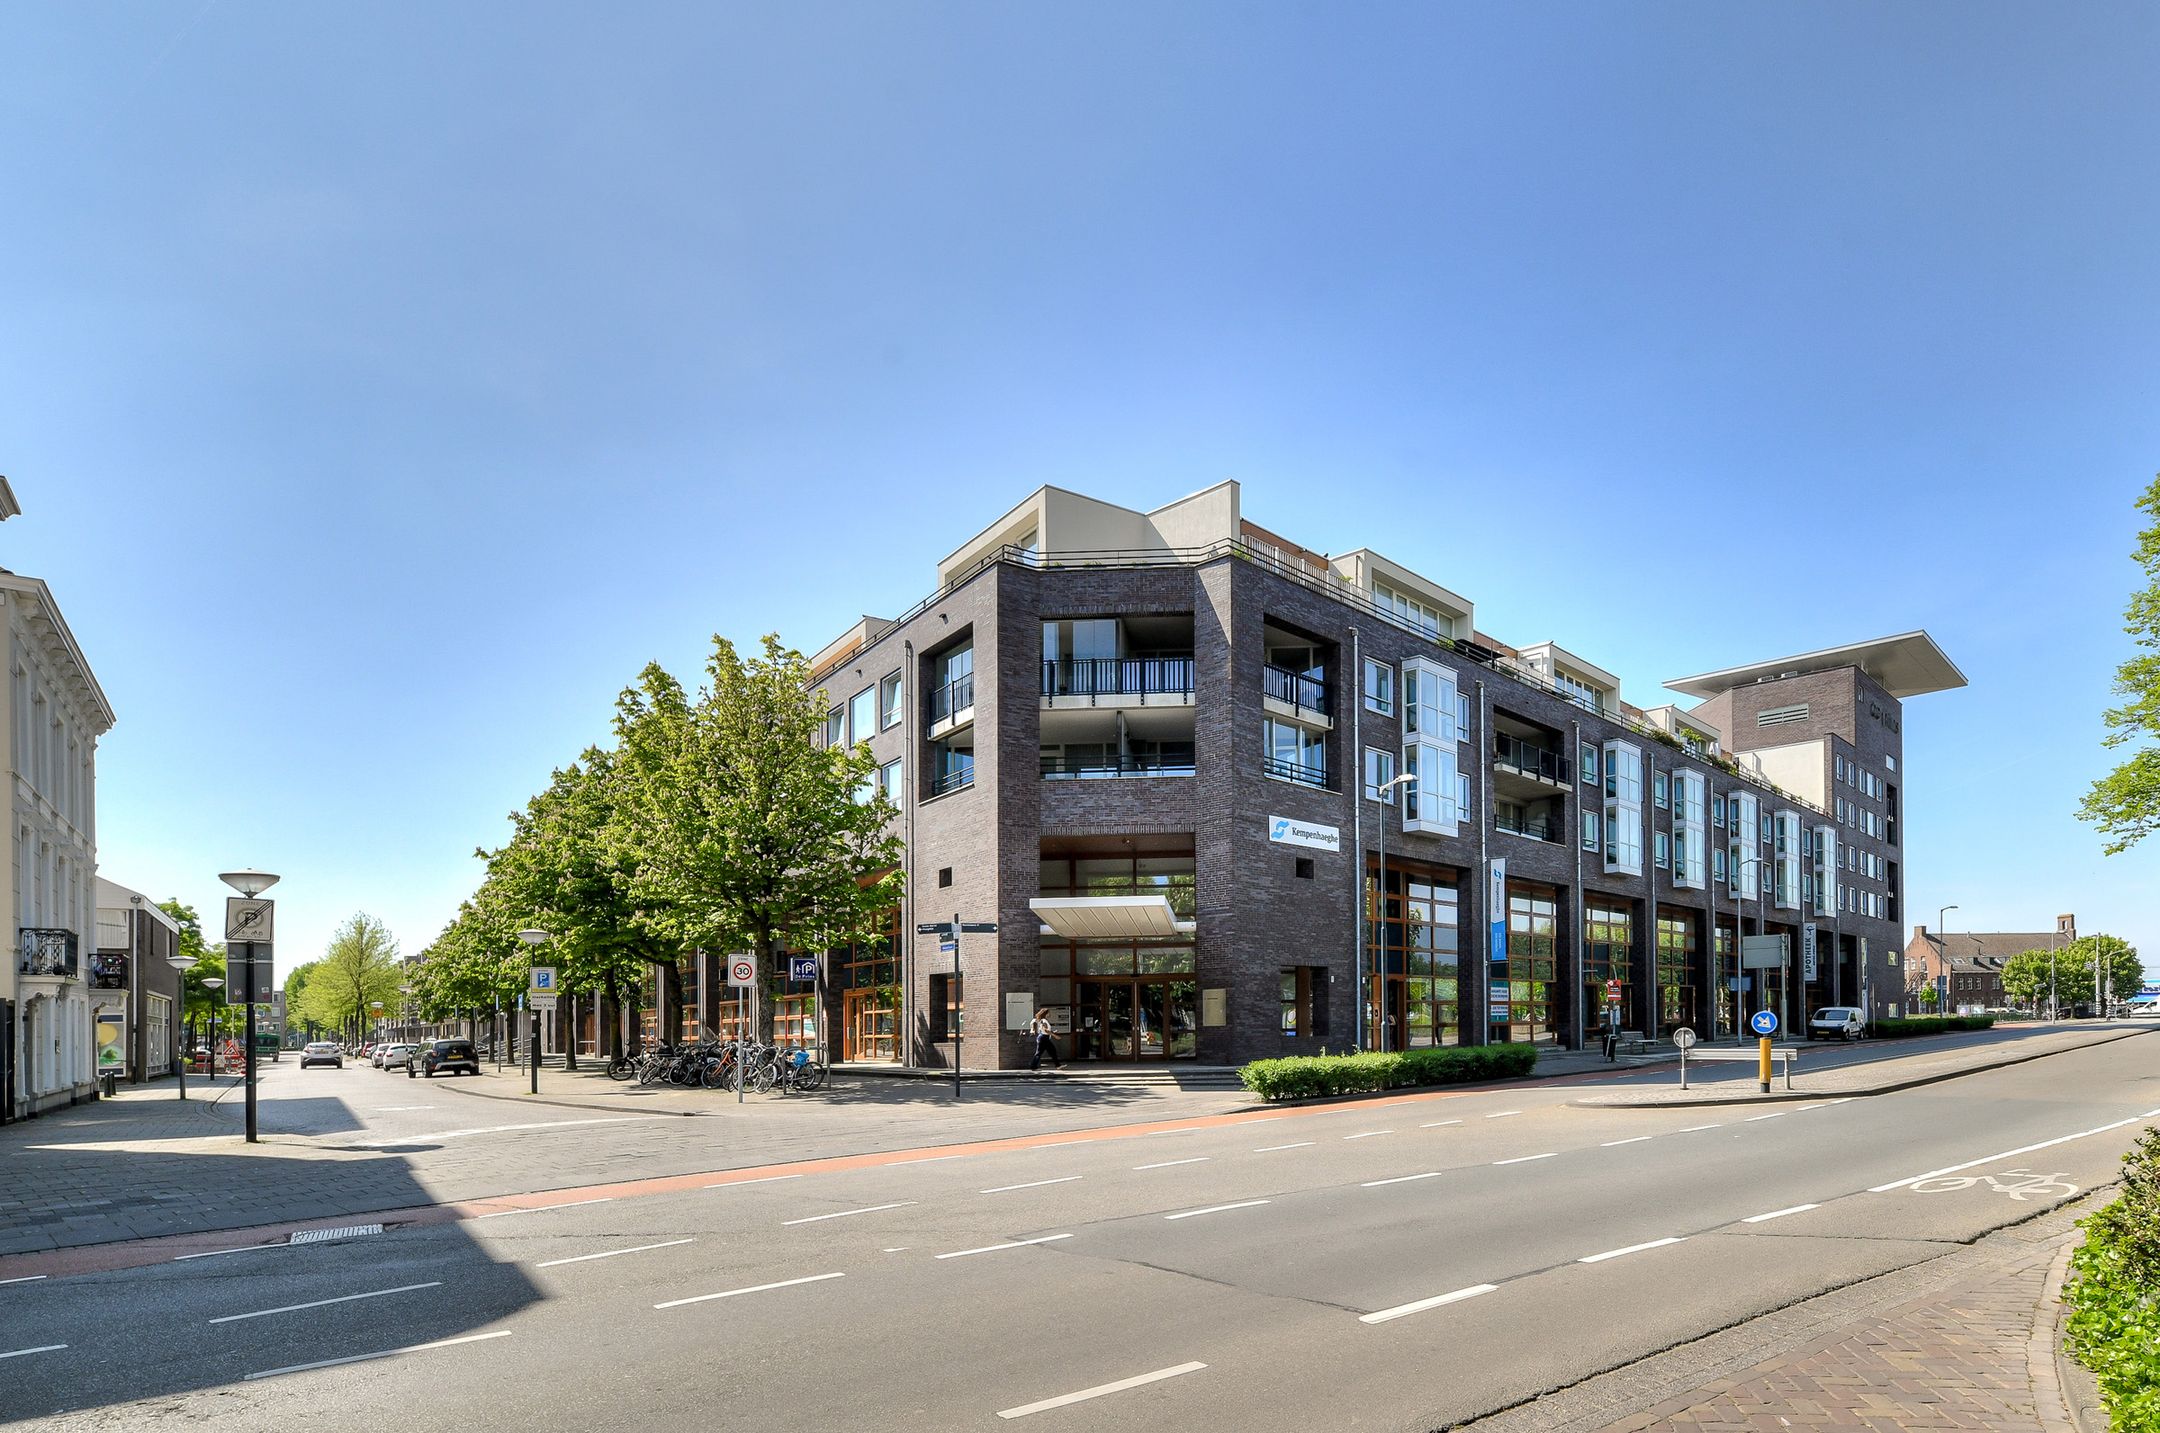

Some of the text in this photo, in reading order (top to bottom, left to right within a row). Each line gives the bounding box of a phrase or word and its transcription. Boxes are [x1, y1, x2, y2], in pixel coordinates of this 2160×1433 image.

[1291, 827, 1338, 844] Kempenhaeghe
[736, 967, 750, 976] 30
[805, 965, 812, 974] P
[540, 973, 547, 982] P
